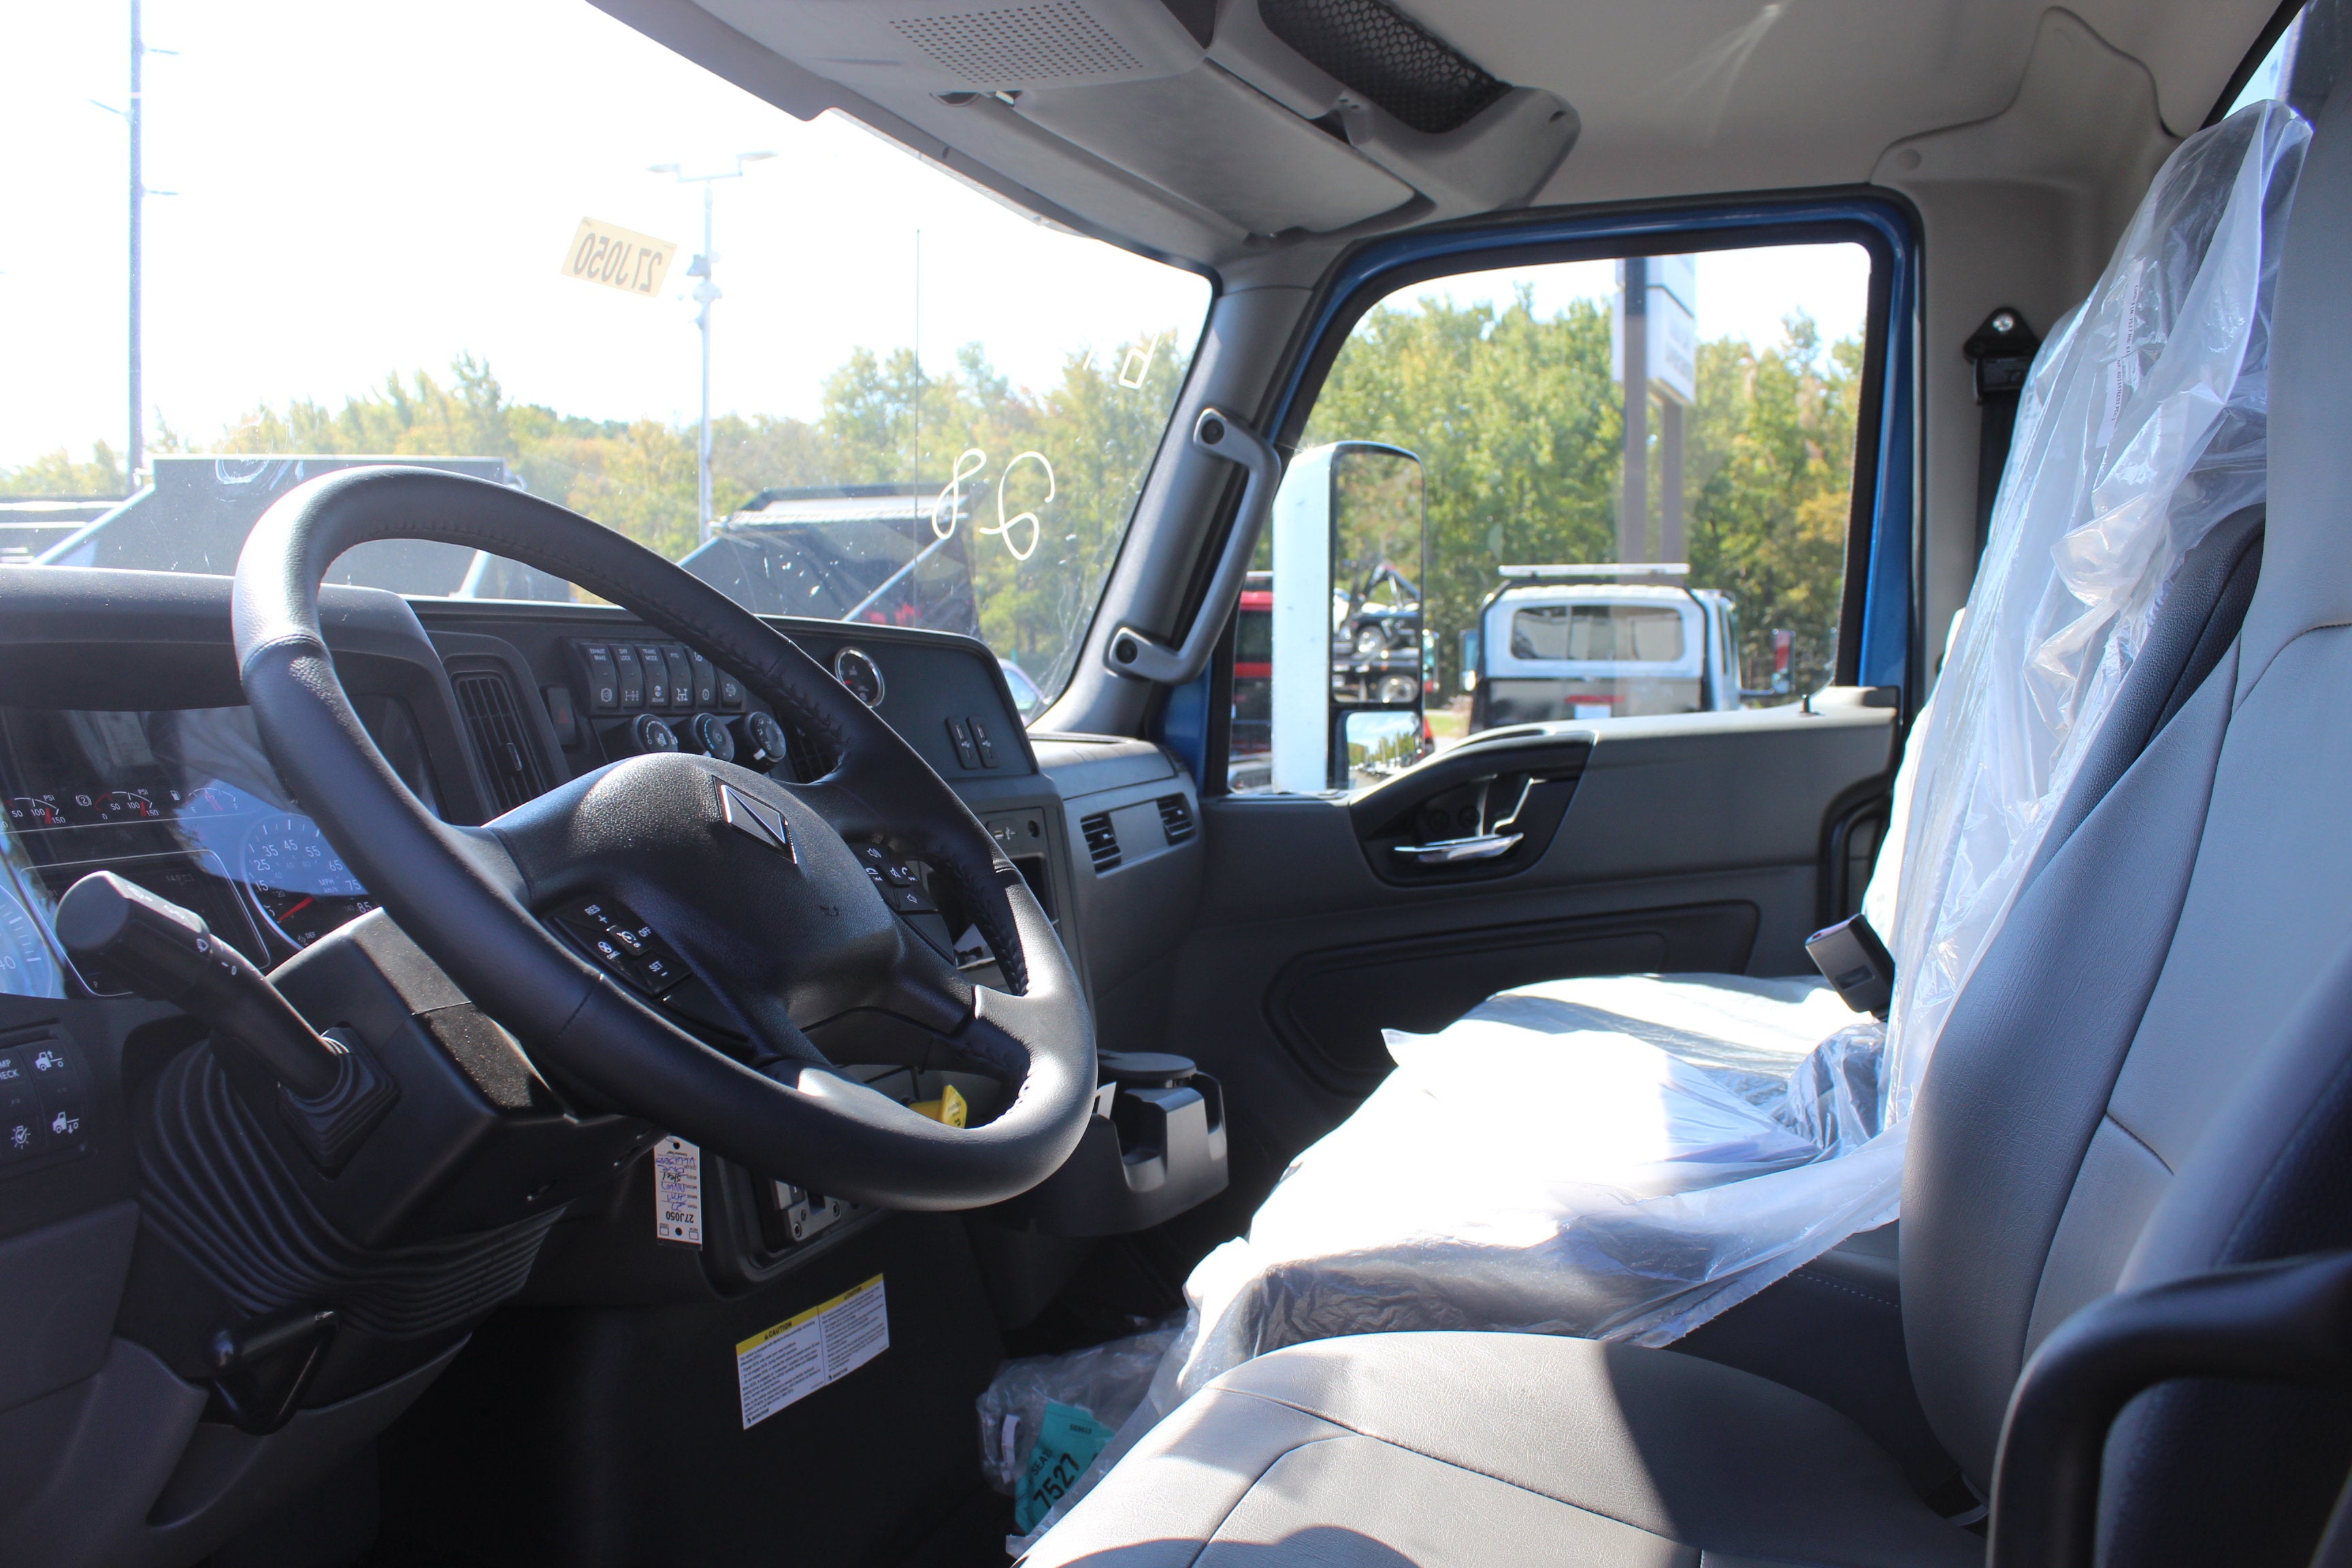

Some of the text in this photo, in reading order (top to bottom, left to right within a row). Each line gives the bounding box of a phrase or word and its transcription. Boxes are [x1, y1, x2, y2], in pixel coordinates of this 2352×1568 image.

[12, 810, 23, 818] 50
[31, 808, 45, 817] 100
[283, 839, 299, 851] 45
[262, 845, 279, 858] 35
[305, 845, 321, 858] 55
[253, 859, 271, 871] 25
[329, 860, 343, 872] 65
[255, 880, 269, 892] 15
[345, 879, 362, 892] 75
[584, 904, 601, 916] RES
[638, 926, 652, 938] OFF
[649, 960, 664, 973] SET
[666, 1211, 694, 1224] 27J050
[768, 1321, 793, 1338] CAUTION
[1032, 1452, 1080, 1509] 7527
